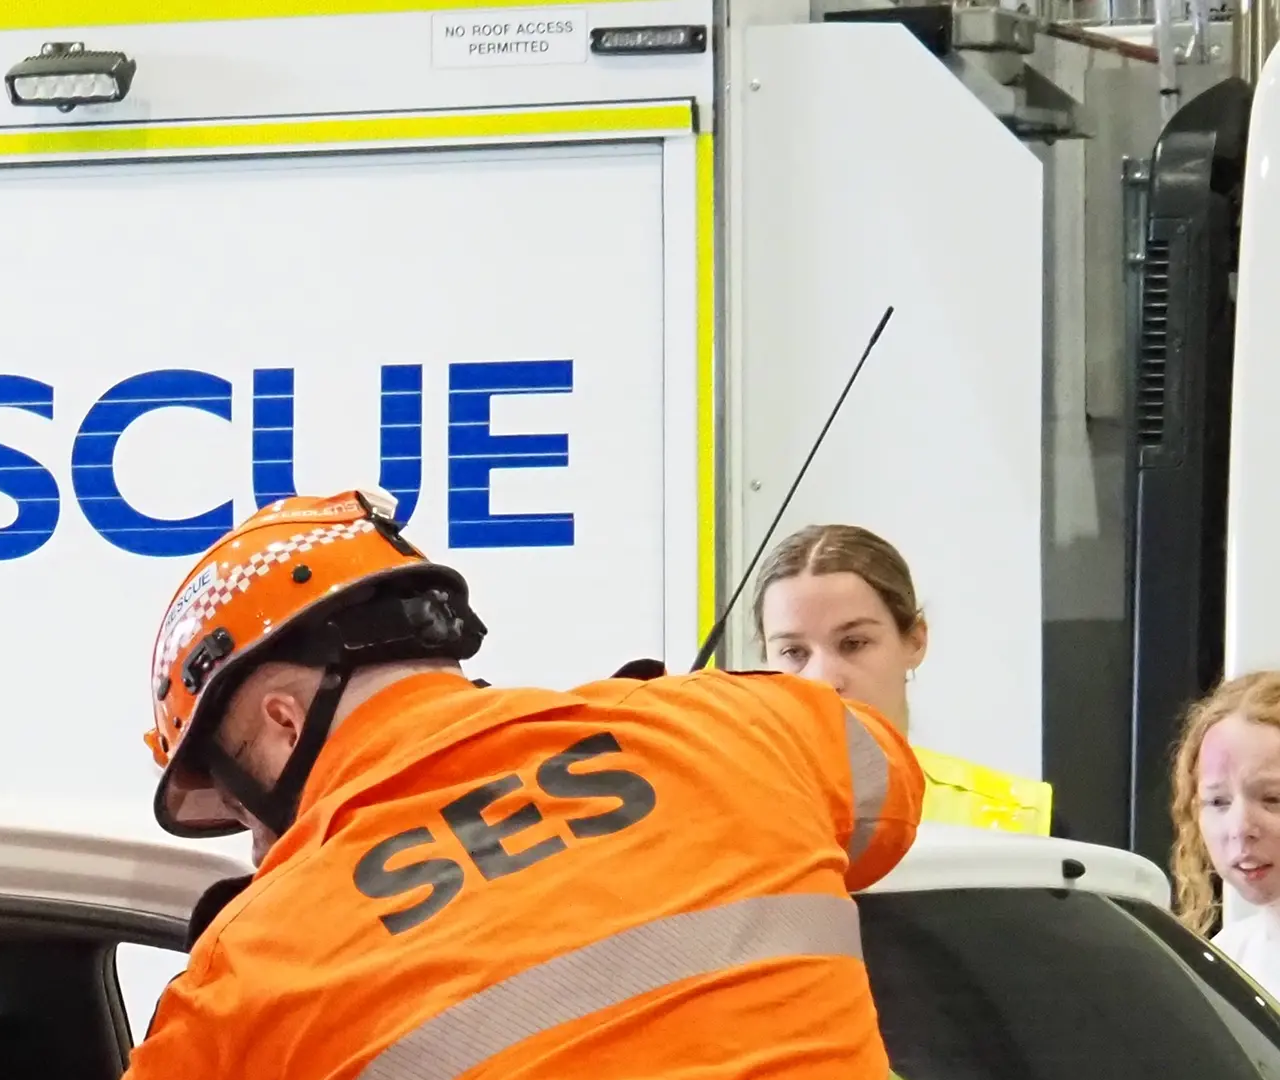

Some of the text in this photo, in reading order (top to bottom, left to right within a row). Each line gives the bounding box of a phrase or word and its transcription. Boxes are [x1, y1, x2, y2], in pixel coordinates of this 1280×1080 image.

[444, 21, 574, 38] NO ROOF ACCESS
[468, 41, 550, 55] PERMITTED
[353, 731, 656, 935] SES
